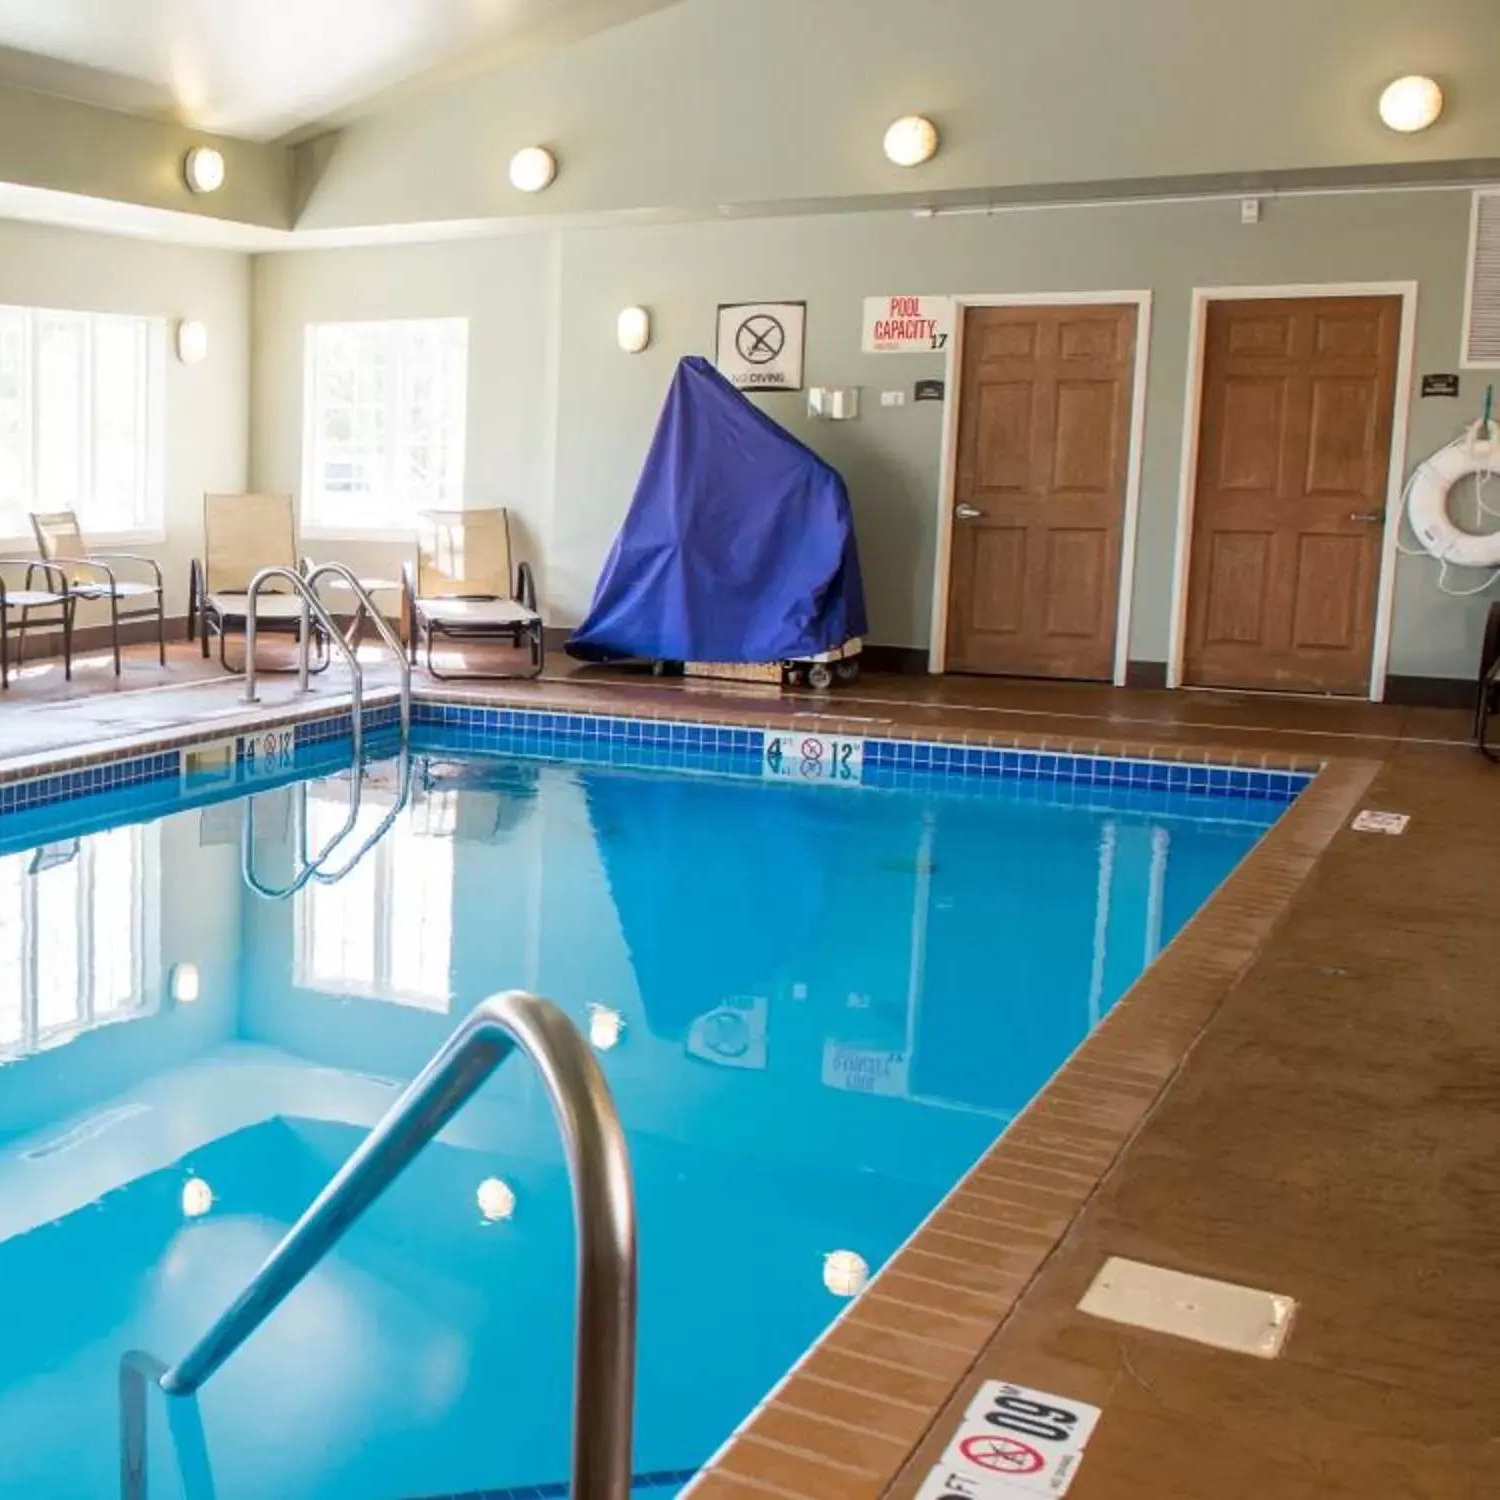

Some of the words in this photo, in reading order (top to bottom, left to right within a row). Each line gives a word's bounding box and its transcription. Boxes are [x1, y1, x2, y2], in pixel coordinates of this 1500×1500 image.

[890, 297, 921, 317] POOL
[875, 319, 937, 339] CAPACITY
[931, 333, 948, 349] 17
[767, 737, 783, 757] 4
[983, 1395, 1080, 1442] 09
